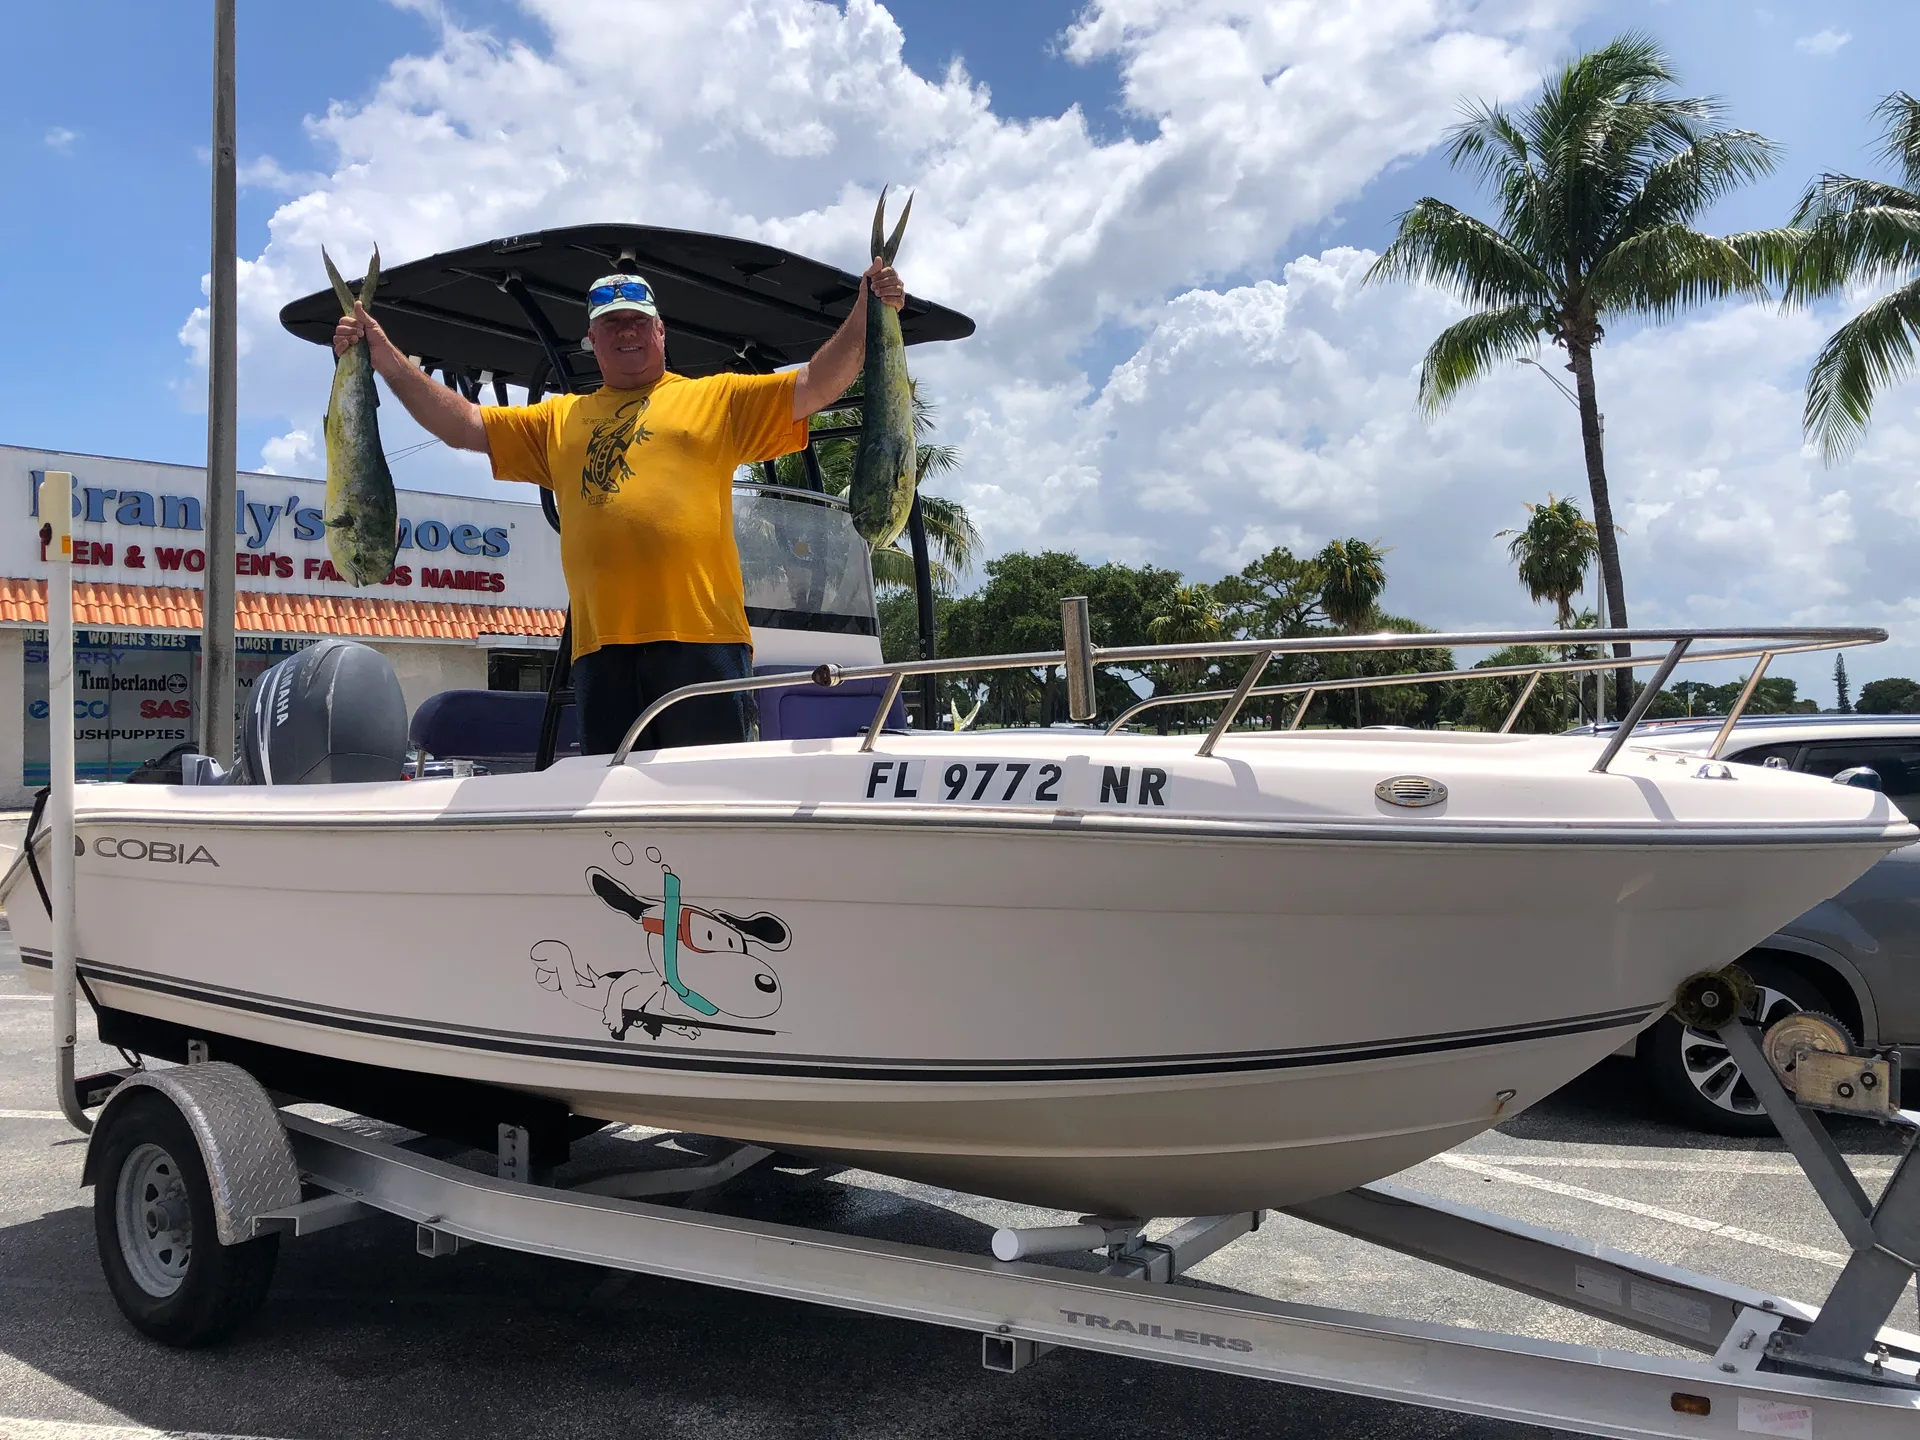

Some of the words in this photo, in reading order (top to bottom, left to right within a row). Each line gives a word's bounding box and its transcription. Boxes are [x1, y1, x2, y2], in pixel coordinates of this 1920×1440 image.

[398, 517, 510, 557] oes
[41, 540, 113, 566] EN
[124, 545, 146, 569] &
[155, 547, 294, 578] WOEN'S
[421, 568, 505, 592] NAMES
[151, 634, 186, 647] SIZES
[235, 638, 275, 650] LMOST
[25, 650, 125, 664] SRRY
[79, 670, 167, 692] Timberland
[277, 660, 298, 727] AMAHA
[29, 700, 109, 719] eco
[140, 699, 191, 719] SAS
[74, 729, 185, 740] USHPUPPIES
[866, 762, 917, 798] FL
[944, 764, 1062, 801] 9772
[1100, 766, 1167, 805] NR
[93, 837, 220, 867] COBIA
[1060, 1309, 1253, 1352] TRAILERS
